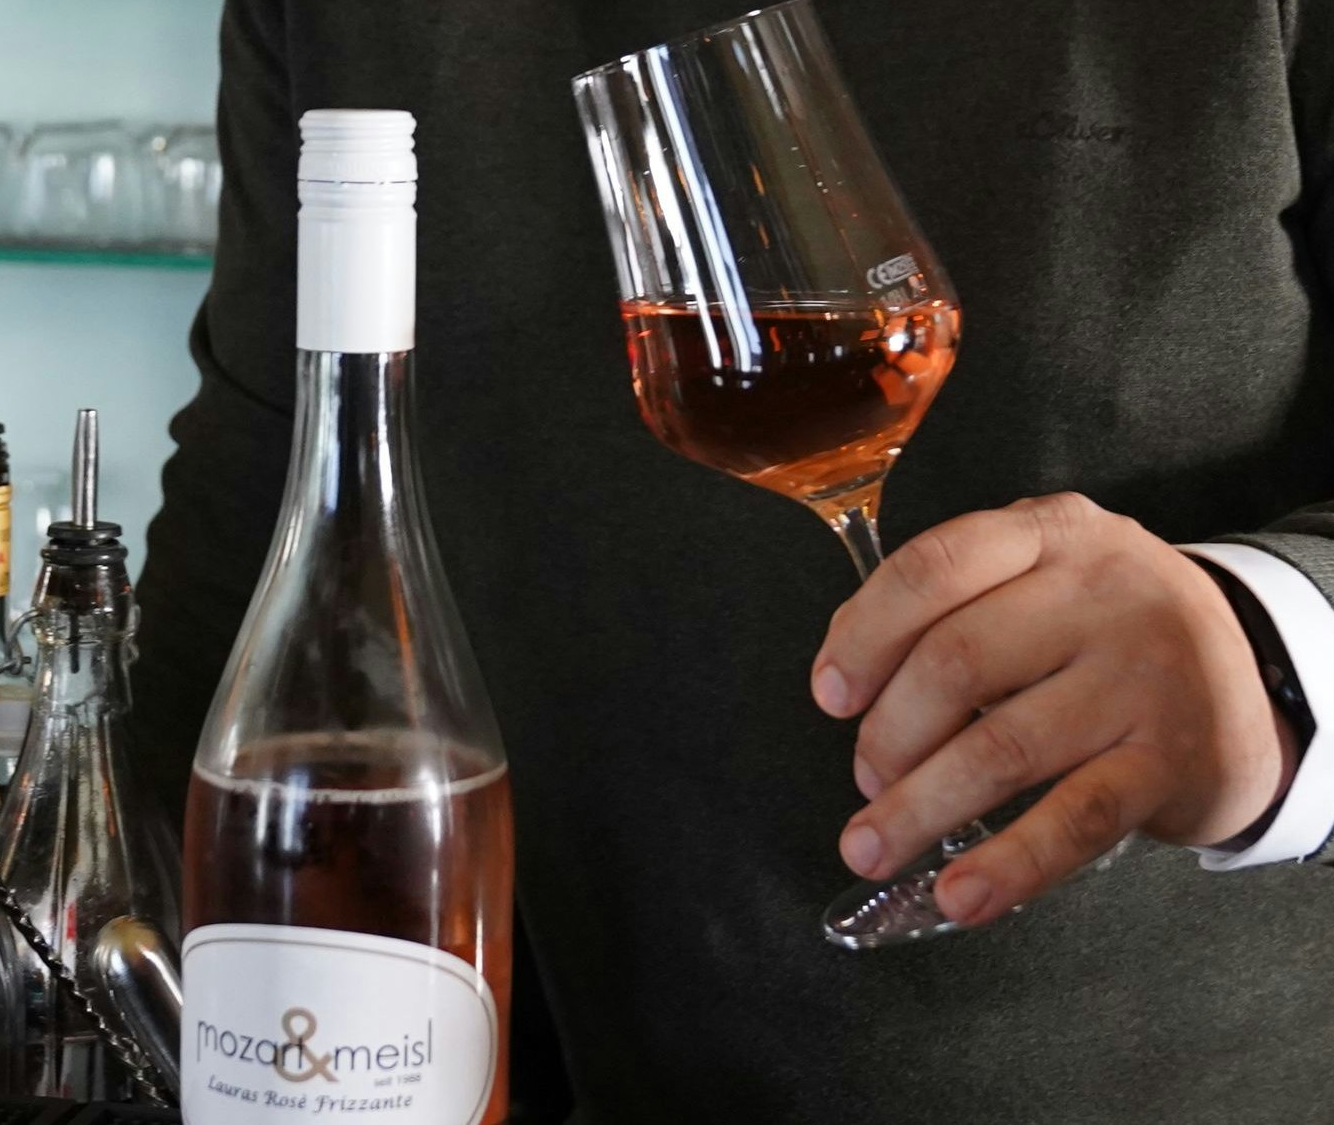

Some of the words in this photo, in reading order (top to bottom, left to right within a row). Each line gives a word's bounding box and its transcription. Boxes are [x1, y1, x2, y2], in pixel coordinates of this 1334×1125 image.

[196, 1020, 304, 1070] mozart
[275, 1006, 339, 1083] &
[333, 1018, 433, 1071] meisl
[207, 1074, 259, 1103] Lauras
[263, 1088, 308, 1110] Rosé
[313, 1093, 414, 1115] Frizzante
